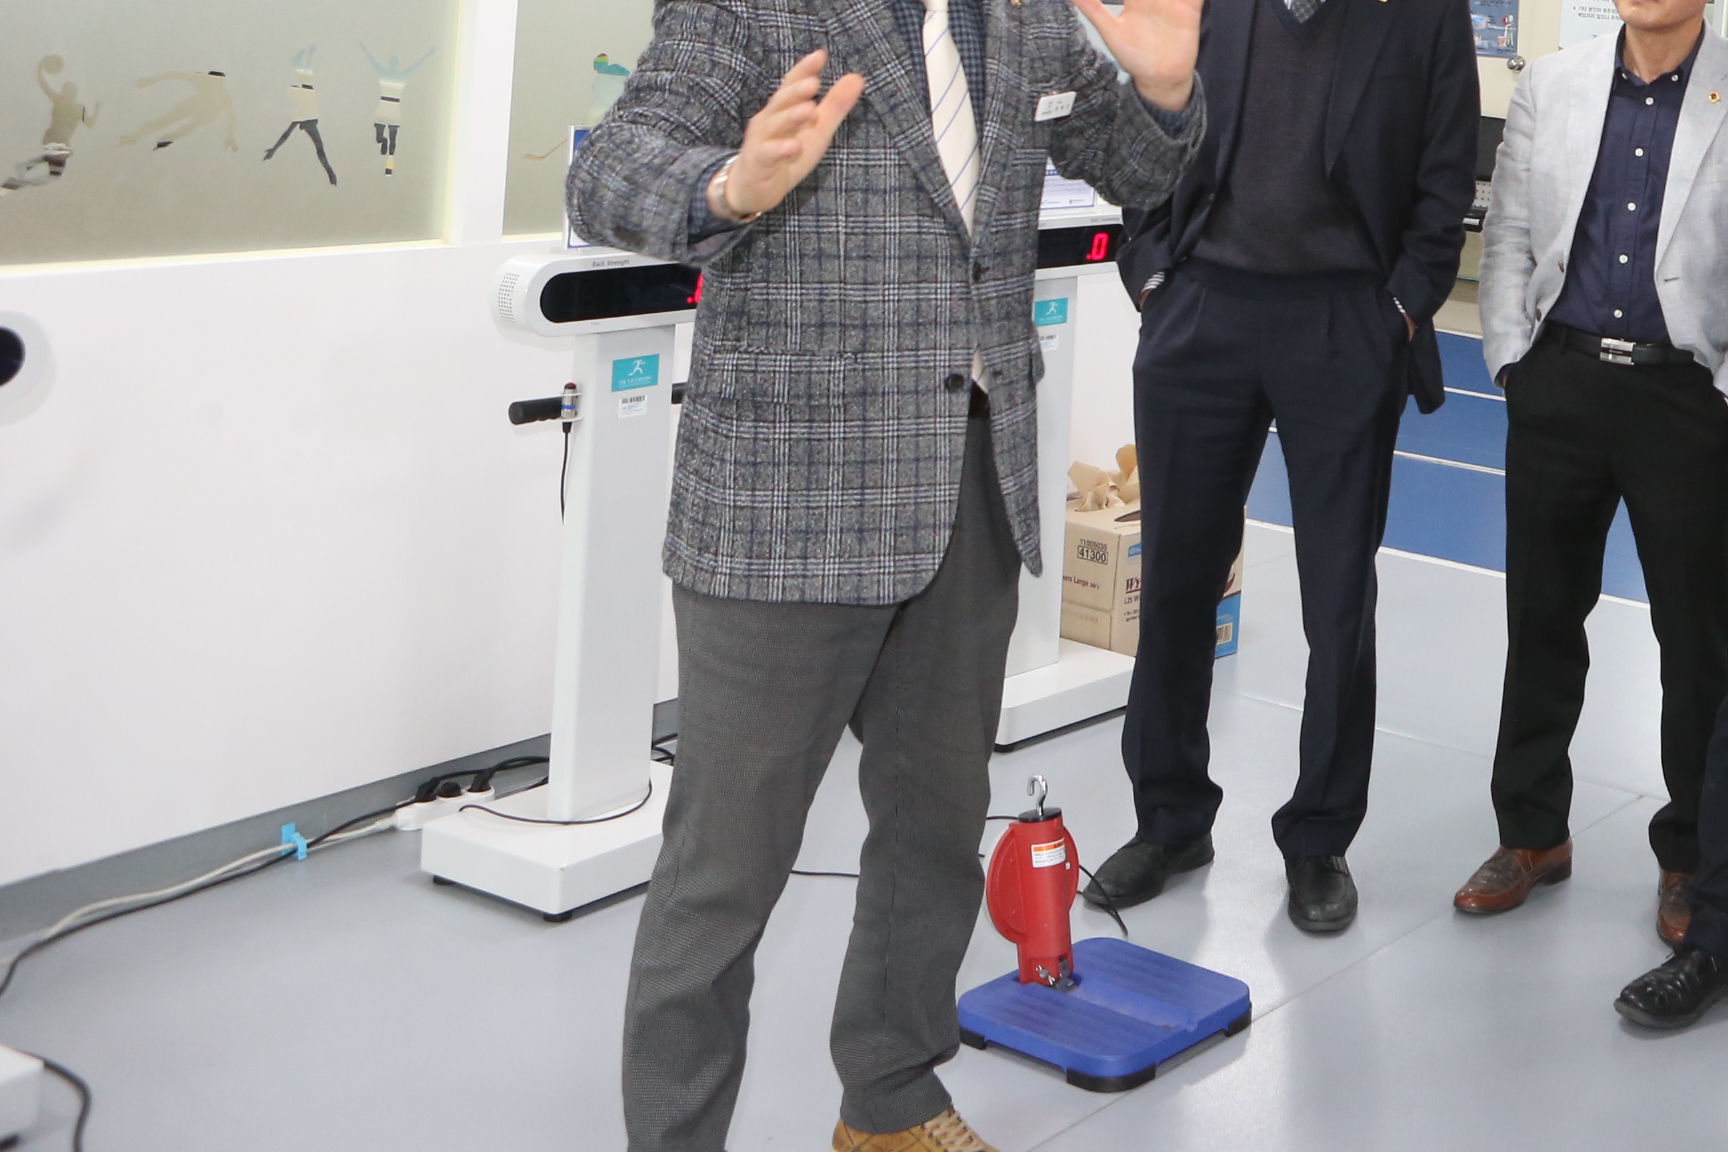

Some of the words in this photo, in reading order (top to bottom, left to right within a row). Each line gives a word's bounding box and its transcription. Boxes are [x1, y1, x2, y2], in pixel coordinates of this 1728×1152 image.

[607, 258, 630, 267] Strength
[1079, 548, 1107, 564] 41300
[1073, 576, 1090, 588] Large
